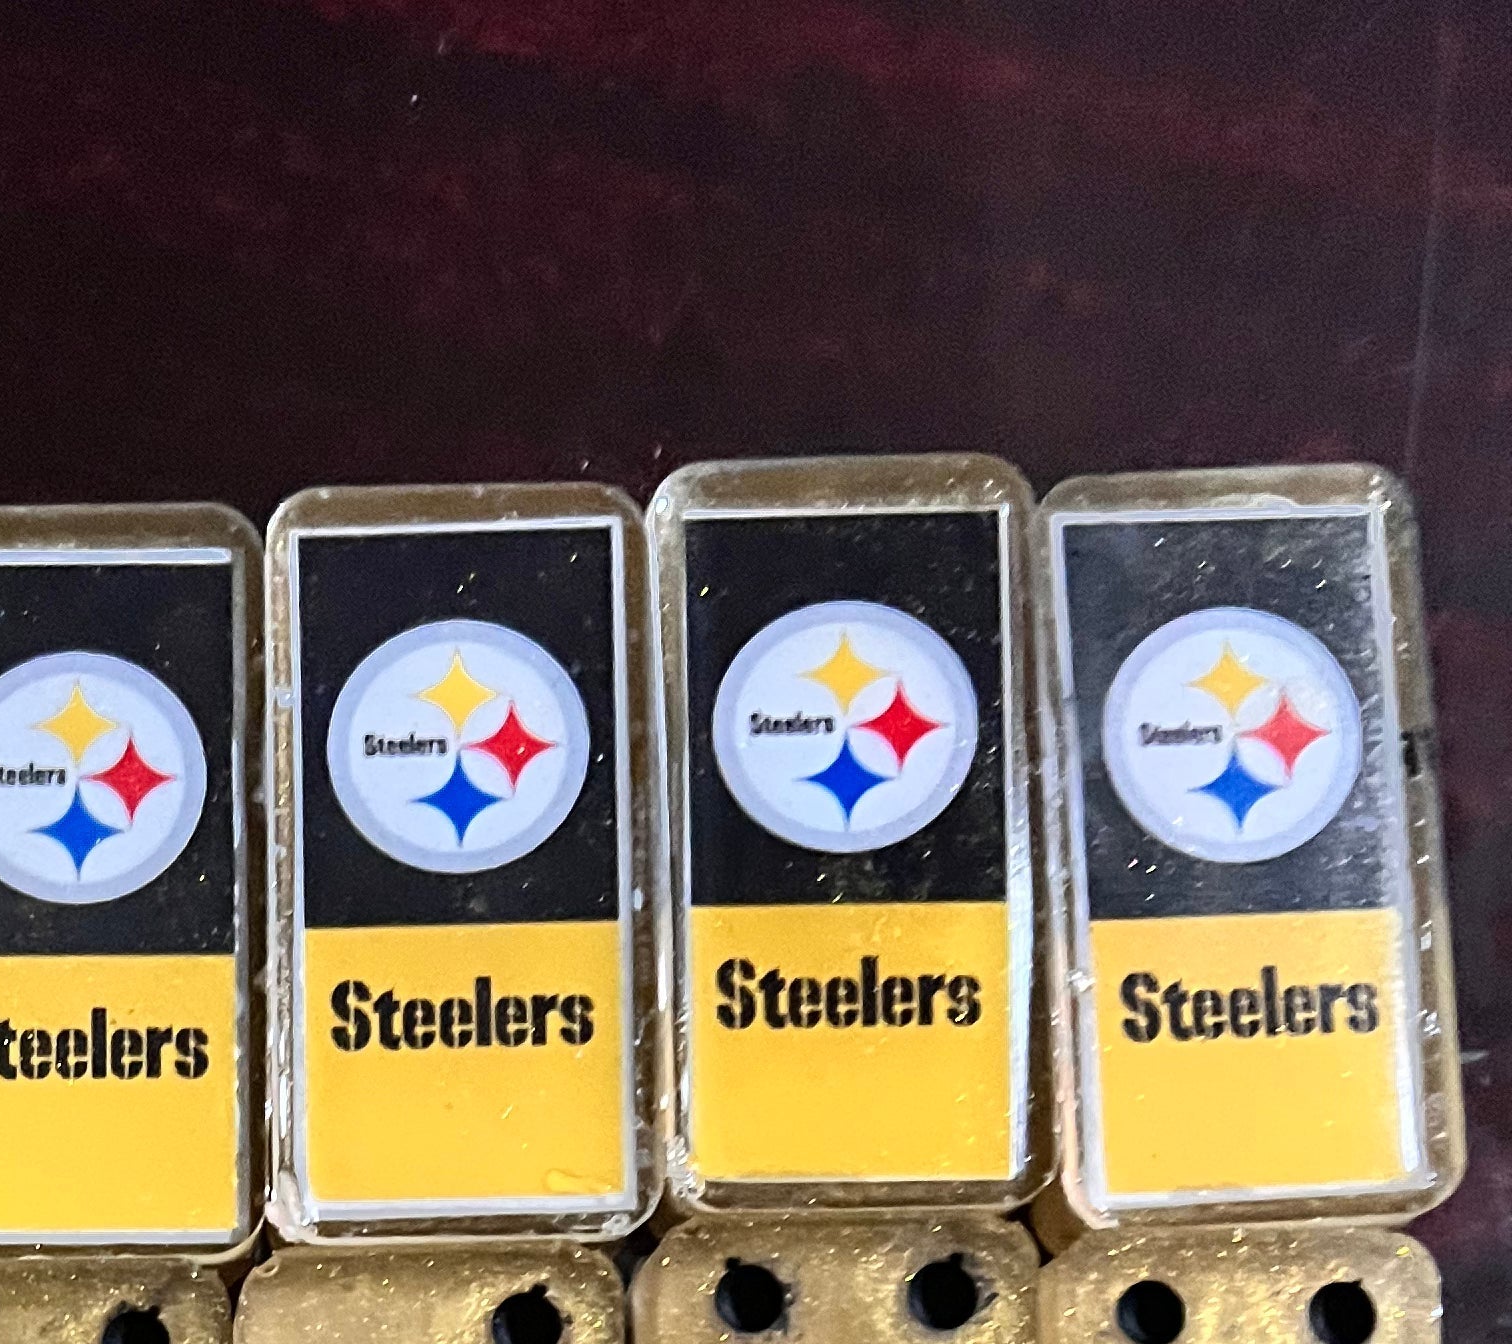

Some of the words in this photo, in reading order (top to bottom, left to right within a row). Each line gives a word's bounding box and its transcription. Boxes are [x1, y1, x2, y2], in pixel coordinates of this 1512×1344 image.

[331, 977, 593, 1051] Steelers
[717, 956, 980, 1028] Steelers
[1122, 966, 1378, 1041] Steelers
